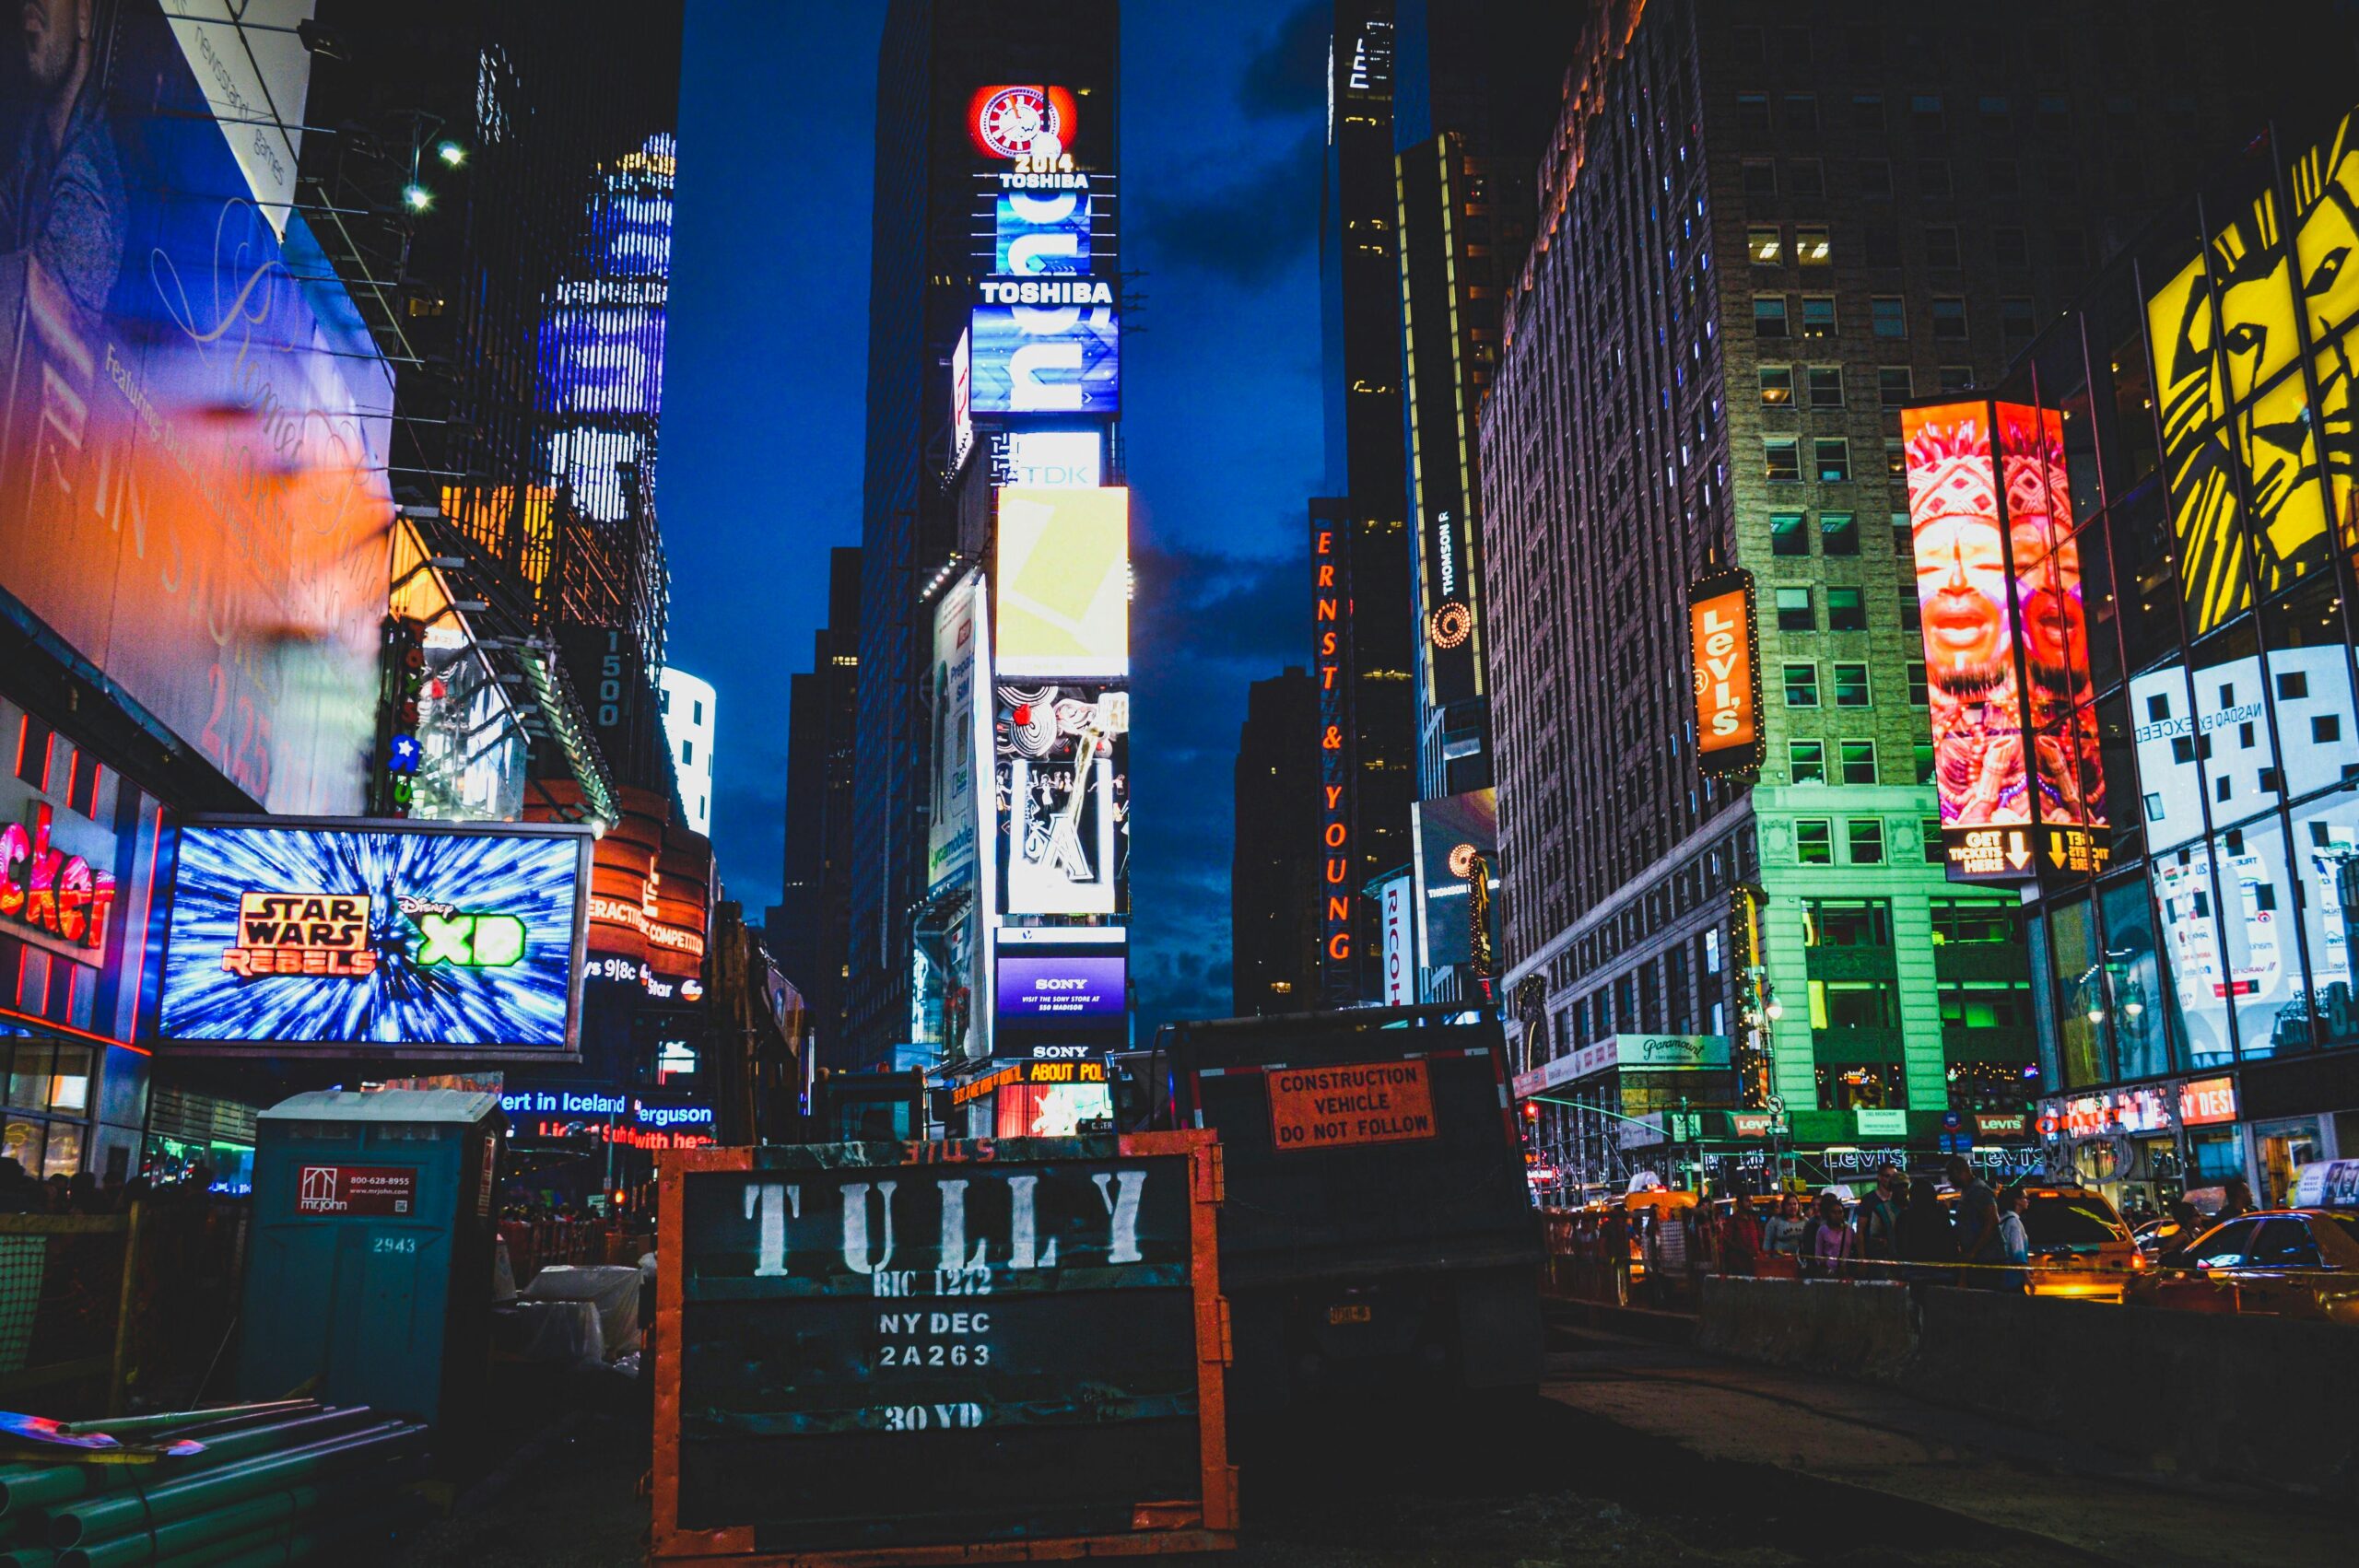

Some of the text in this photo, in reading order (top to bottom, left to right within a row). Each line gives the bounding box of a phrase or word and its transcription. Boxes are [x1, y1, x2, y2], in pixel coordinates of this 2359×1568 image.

[1015, 154, 1074, 173] 2014
[1000, 174, 1088, 188] TOSHIBA
[980, 282, 1113, 304] TOSHIBA
[105, 343, 163, 442] Featuring
[1021, 466, 1087, 484] TDK
[1438, 522, 1454, 596] THOMSON
[599, 630, 621, 727] 1500
[1703, 610, 1741, 736] Levi's
[1317, 532, 1350, 960] ERNST & YOUNG
[1966, 831, 2002, 848] GET
[1948, 846, 2004, 860] TICKETS
[1965, 858, 2004, 873] HERE
[244, 897, 364, 921] STAR
[244, 921, 364, 945] WARS
[417, 913, 526, 967] XD
[1388, 889, 1401, 1007] RICOH
[222, 948, 377, 976] REBELS
[1035, 978, 1088, 990] SONY
[1033, 1046, 1089, 1058] SONY
[1643, 1038, 1706, 1060] Paramount
[1030, 1063, 1074, 1082] ABOUT
[1280, 1067, 1417, 1093] CONSTRUCTION
[536, 1092, 557, 1111] in
[562, 1092, 626, 1113] Iceland
[1314, 1094, 1391, 1115] VEHICLE
[1280, 1115, 1428, 1142] DO NOT FOLLOW
[1980, 1119, 2022, 1129] Levi's
[350, 1176, 409, 1186] 800-628-8955
[744, 1170, 1147, 1277] TULLY
[373, 1237, 416, 1254] 2943
[933, 1266, 992, 1296] 1272
[880, 1313, 990, 1334] NY DEC
[879, 1344, 991, 1366] 2A263
[885, 1402, 983, 1432] 30 YD
